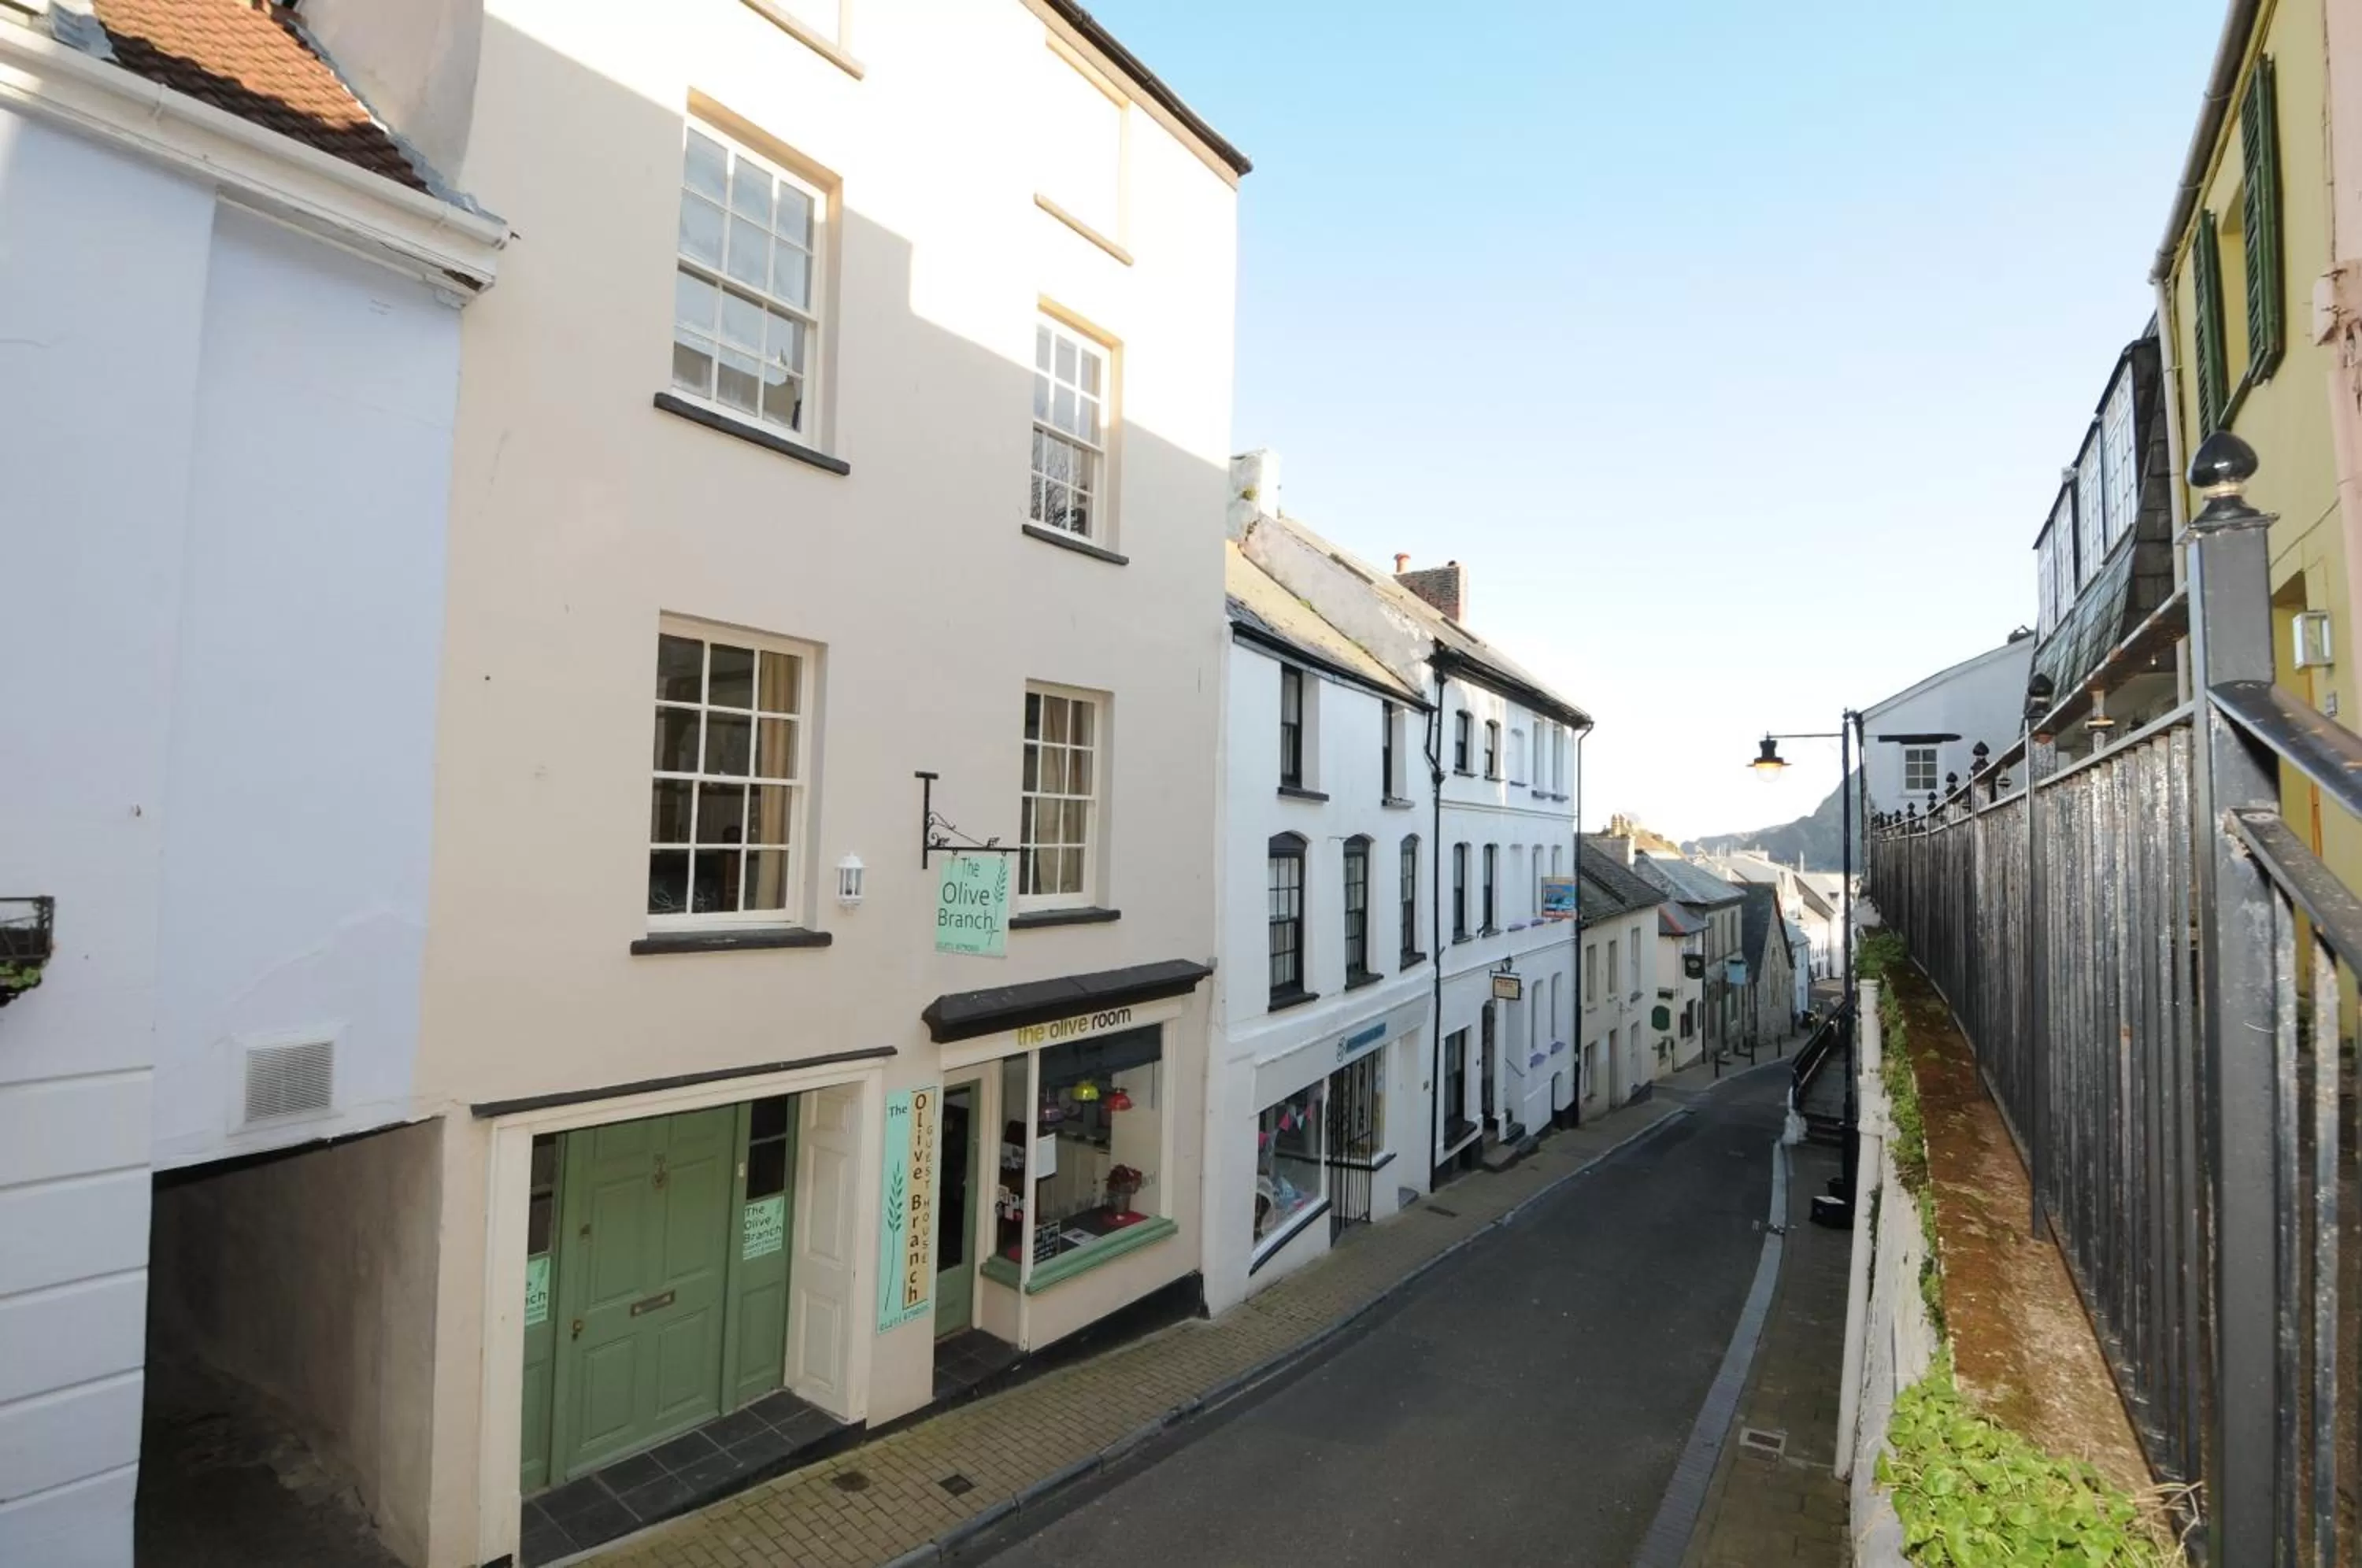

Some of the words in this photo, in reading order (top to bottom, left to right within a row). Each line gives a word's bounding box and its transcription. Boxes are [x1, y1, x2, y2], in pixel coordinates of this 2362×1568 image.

[961, 856, 980, 878] The
[942, 881, 990, 906] Olive
[938, 908, 994, 930] Branch
[1018, 1026, 1045, 1045] the
[1050, 1016, 1089, 1038] olive
[1092, 1008, 1131, 1030] room
[889, 1104, 908, 1118] The
[913, 1093, 927, 1180] Olive
[744, 1204, 765, 1218] The
[744, 1216, 772, 1230] Olive
[921, 1199, 931, 1264] HOUSE
[744, 1226, 782, 1243] Branch
[908, 1193, 922, 1304] Branch
